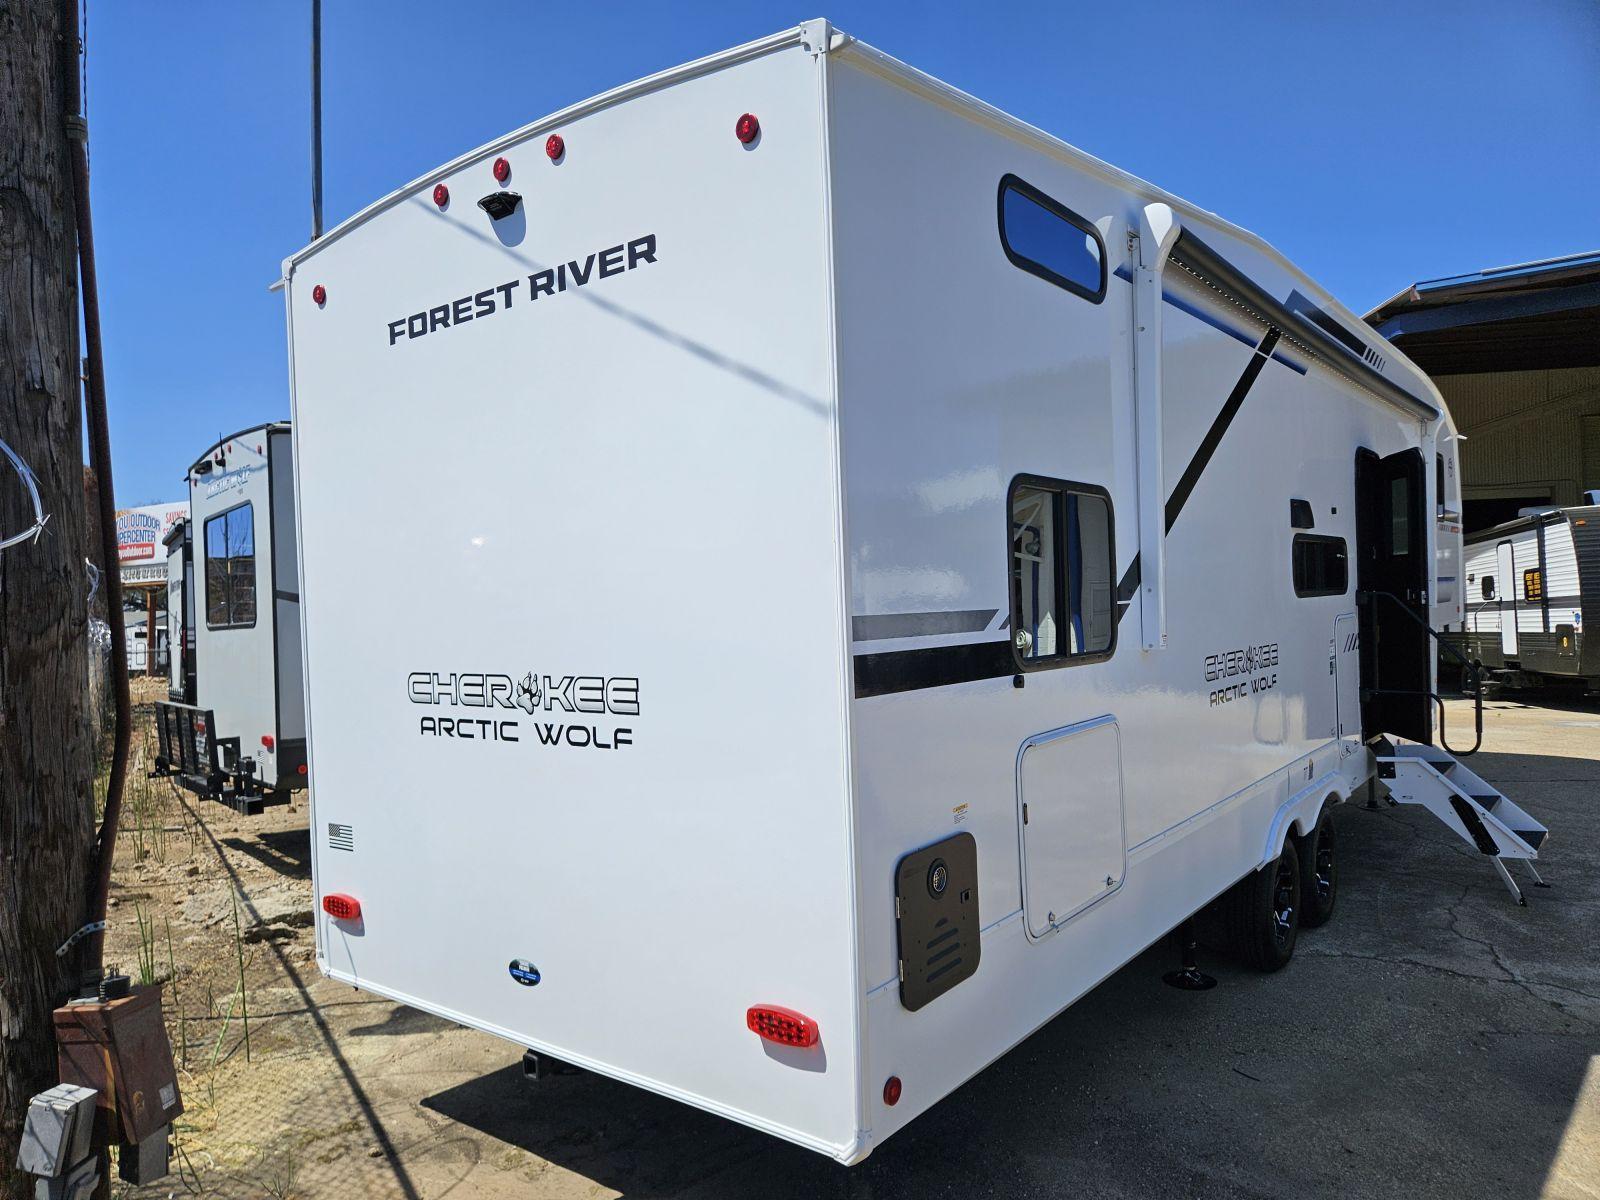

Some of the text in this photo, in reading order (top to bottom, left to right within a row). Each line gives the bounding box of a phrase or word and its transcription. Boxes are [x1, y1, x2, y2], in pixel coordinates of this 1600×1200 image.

[388, 233, 658, 346] FOREST RIVER
[130, 513, 160, 530] OUTDOOR
[1204, 643, 1279, 682] CHERKEE
[407, 671, 640, 716] CHERKEE
[1209, 673, 1277, 708] ARCTIC WOLF
[420, 716, 633, 750] ARCTIC WOLF
